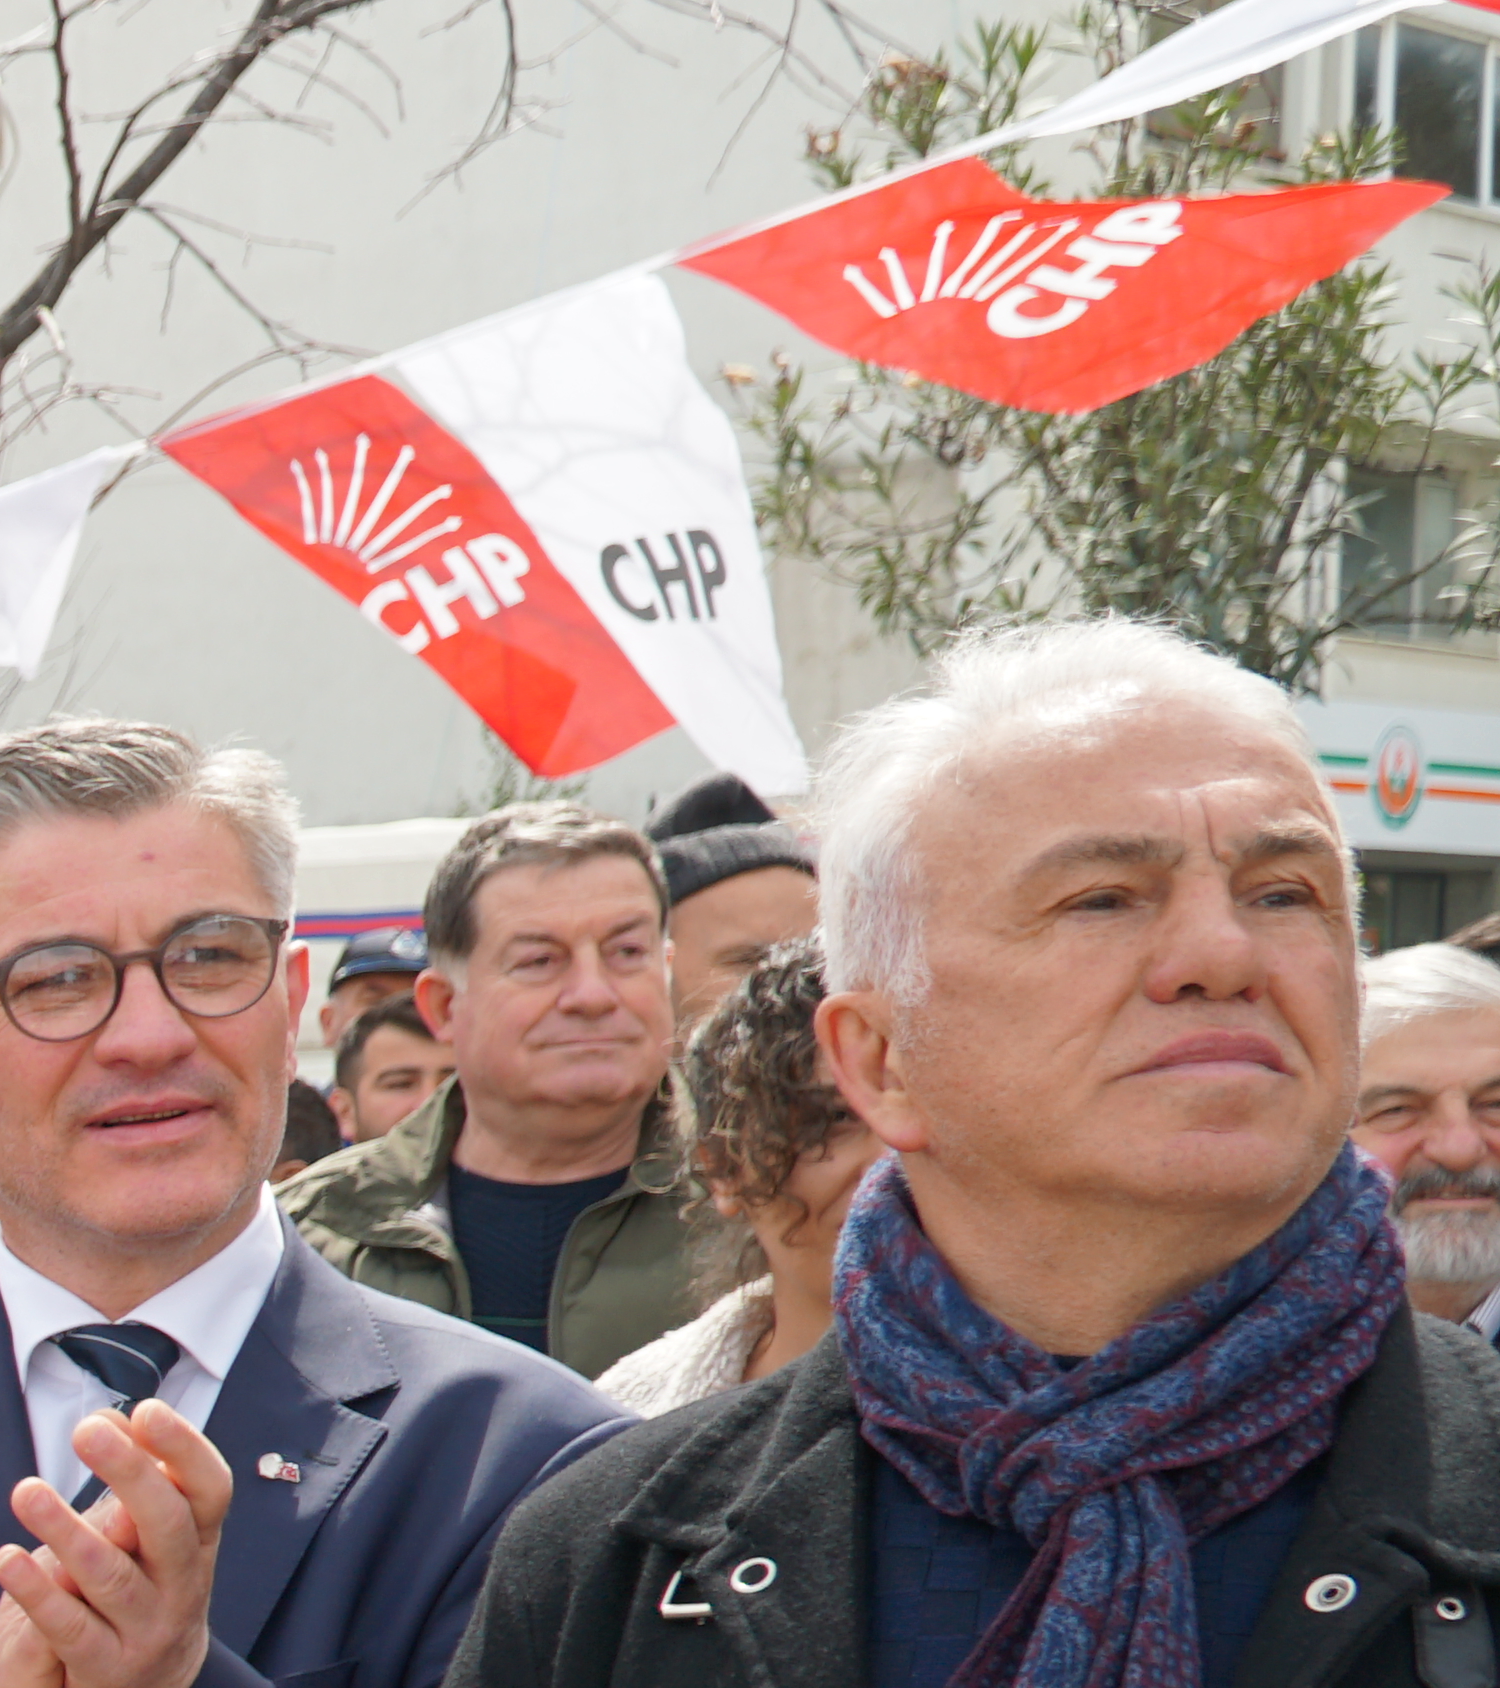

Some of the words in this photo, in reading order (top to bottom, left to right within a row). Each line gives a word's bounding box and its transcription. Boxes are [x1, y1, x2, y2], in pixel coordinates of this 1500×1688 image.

[986, 201, 1184, 338] CHP
[359, 533, 531, 655] CHP
[601, 529, 727, 622] CHP
